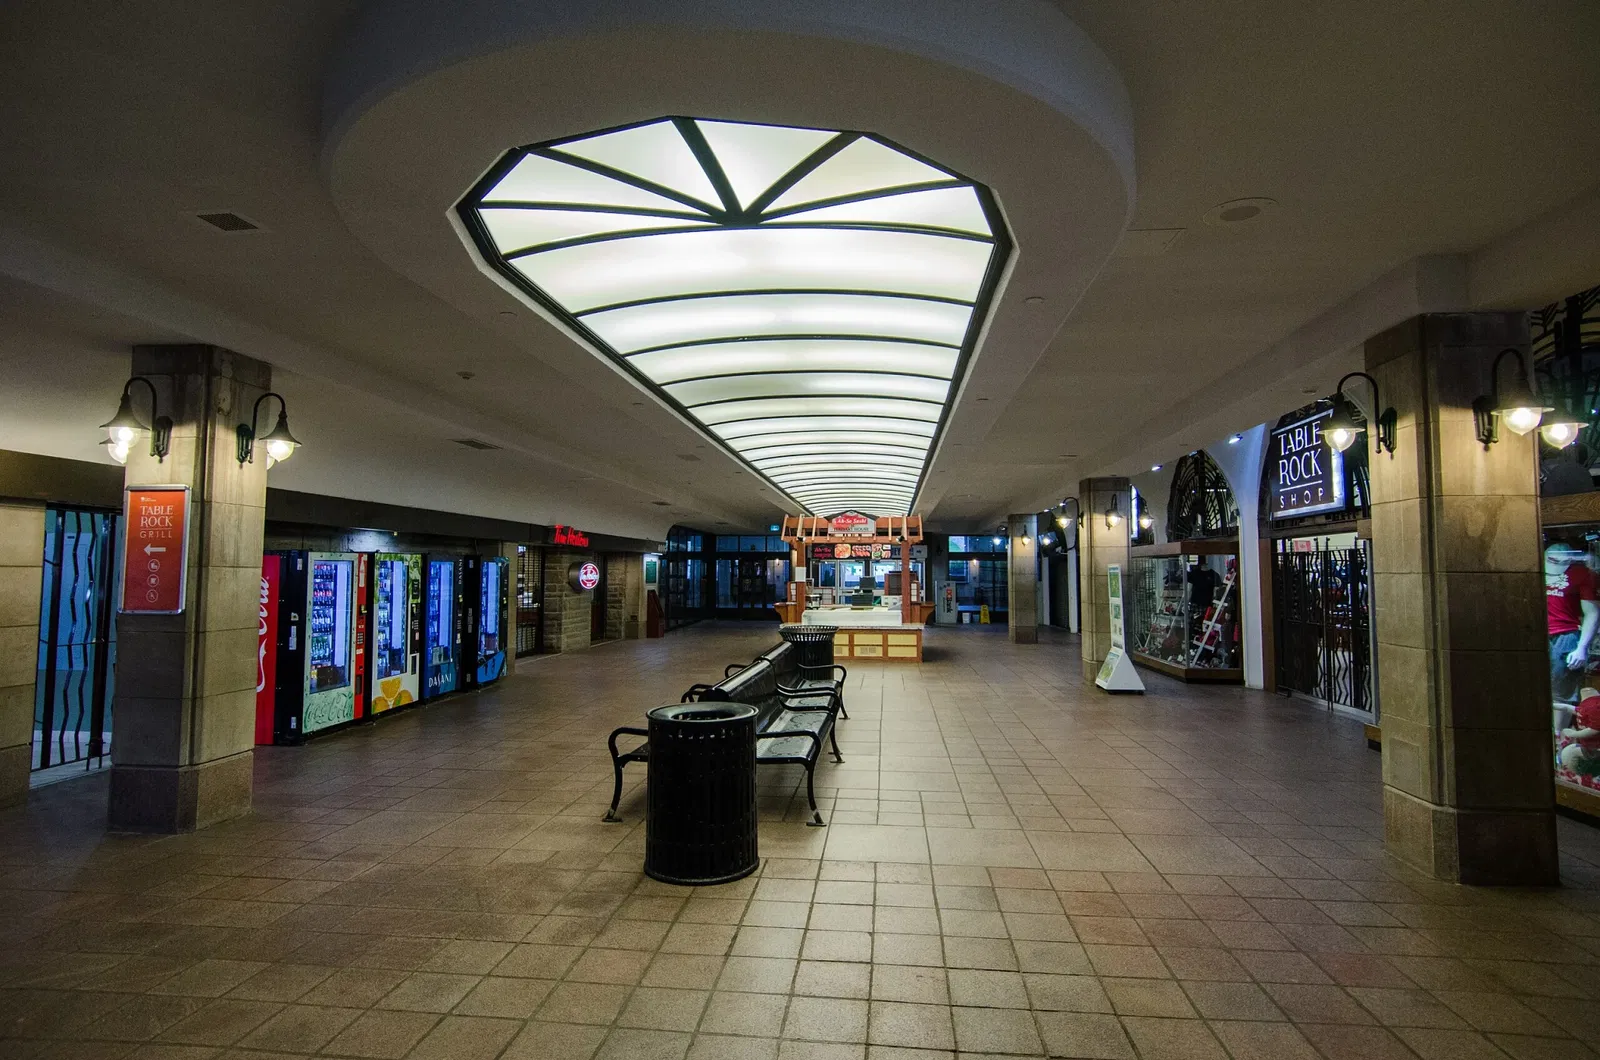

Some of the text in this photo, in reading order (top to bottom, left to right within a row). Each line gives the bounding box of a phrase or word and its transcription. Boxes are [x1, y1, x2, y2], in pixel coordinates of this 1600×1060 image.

[1278, 421, 1322, 456] TABLE
[1279, 448, 1323, 486] ROCK
[1279, 487, 1324, 509] SHOP
[140, 505, 173, 515] TABLE
[140, 516, 172, 528] ROCK
[428, 673, 452, 688] DASANI
[303, 692, 353, 729] Coca-Cola
